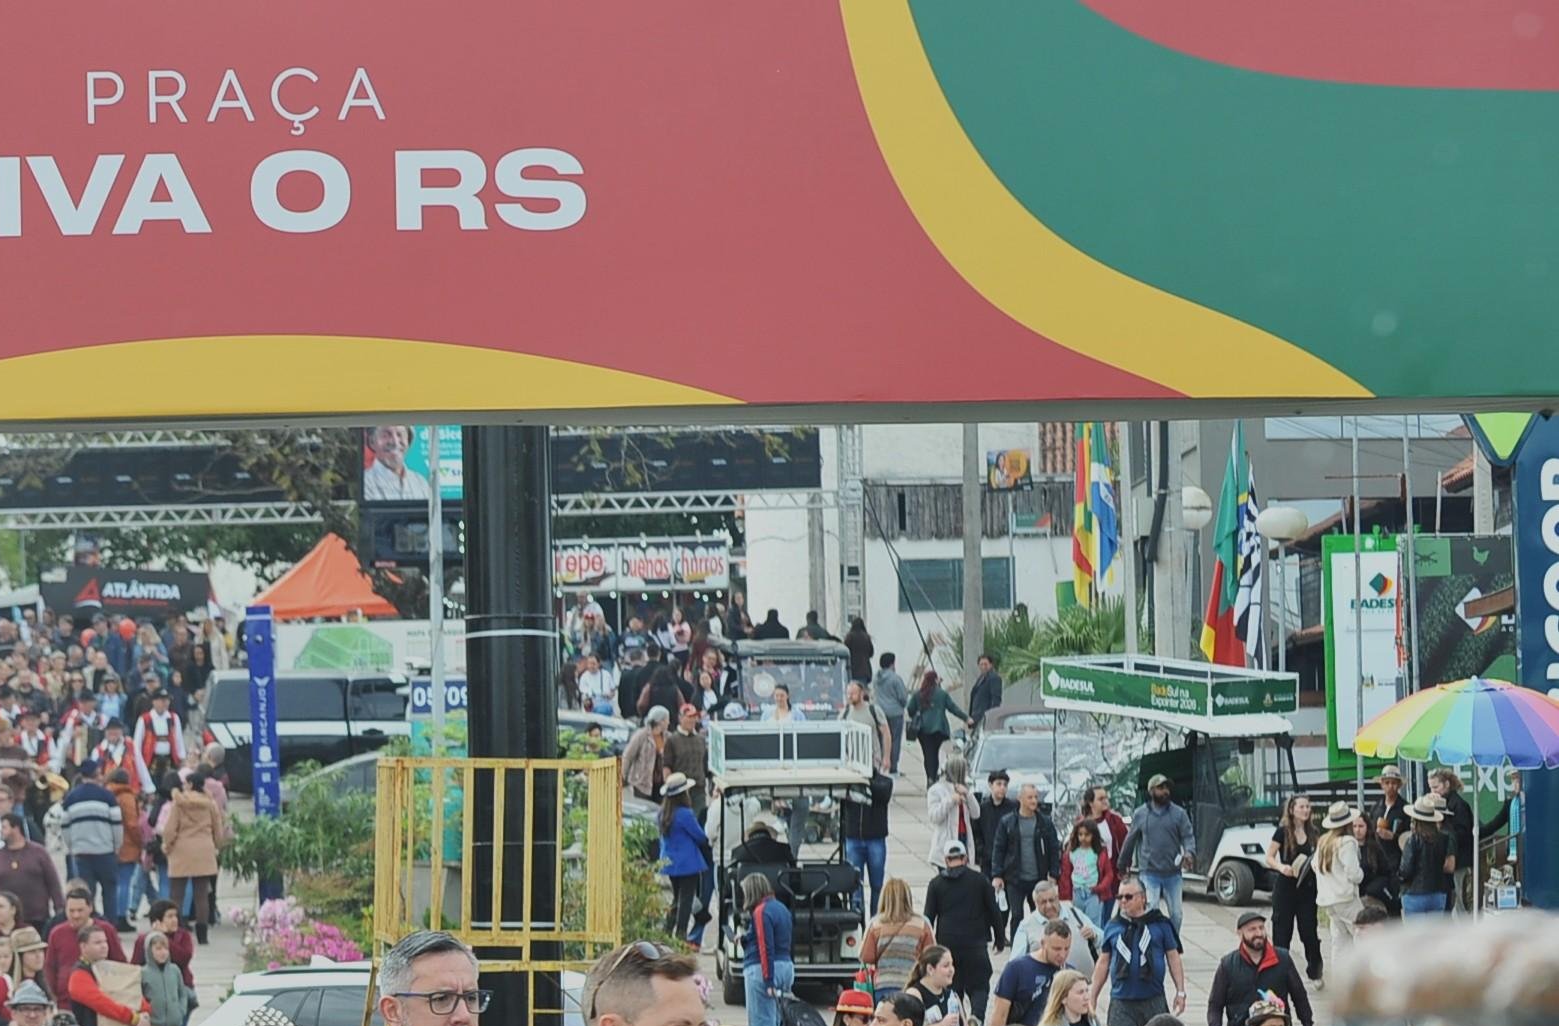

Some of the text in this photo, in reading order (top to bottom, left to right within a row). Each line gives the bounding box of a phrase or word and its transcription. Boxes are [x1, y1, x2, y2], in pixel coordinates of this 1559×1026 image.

[85, 67, 386, 136] PRAÇA
[250, 149, 351, 233] O
[395, 147, 587, 231] RS
[621, 551, 669, 579] buenas
[675, 550, 724, 578] churros
[102, 579, 181, 600] ATLÂNTIDA
[1351, 598, 1395, 609] ADES
[1060, 677, 1095, 694] BADESUL
